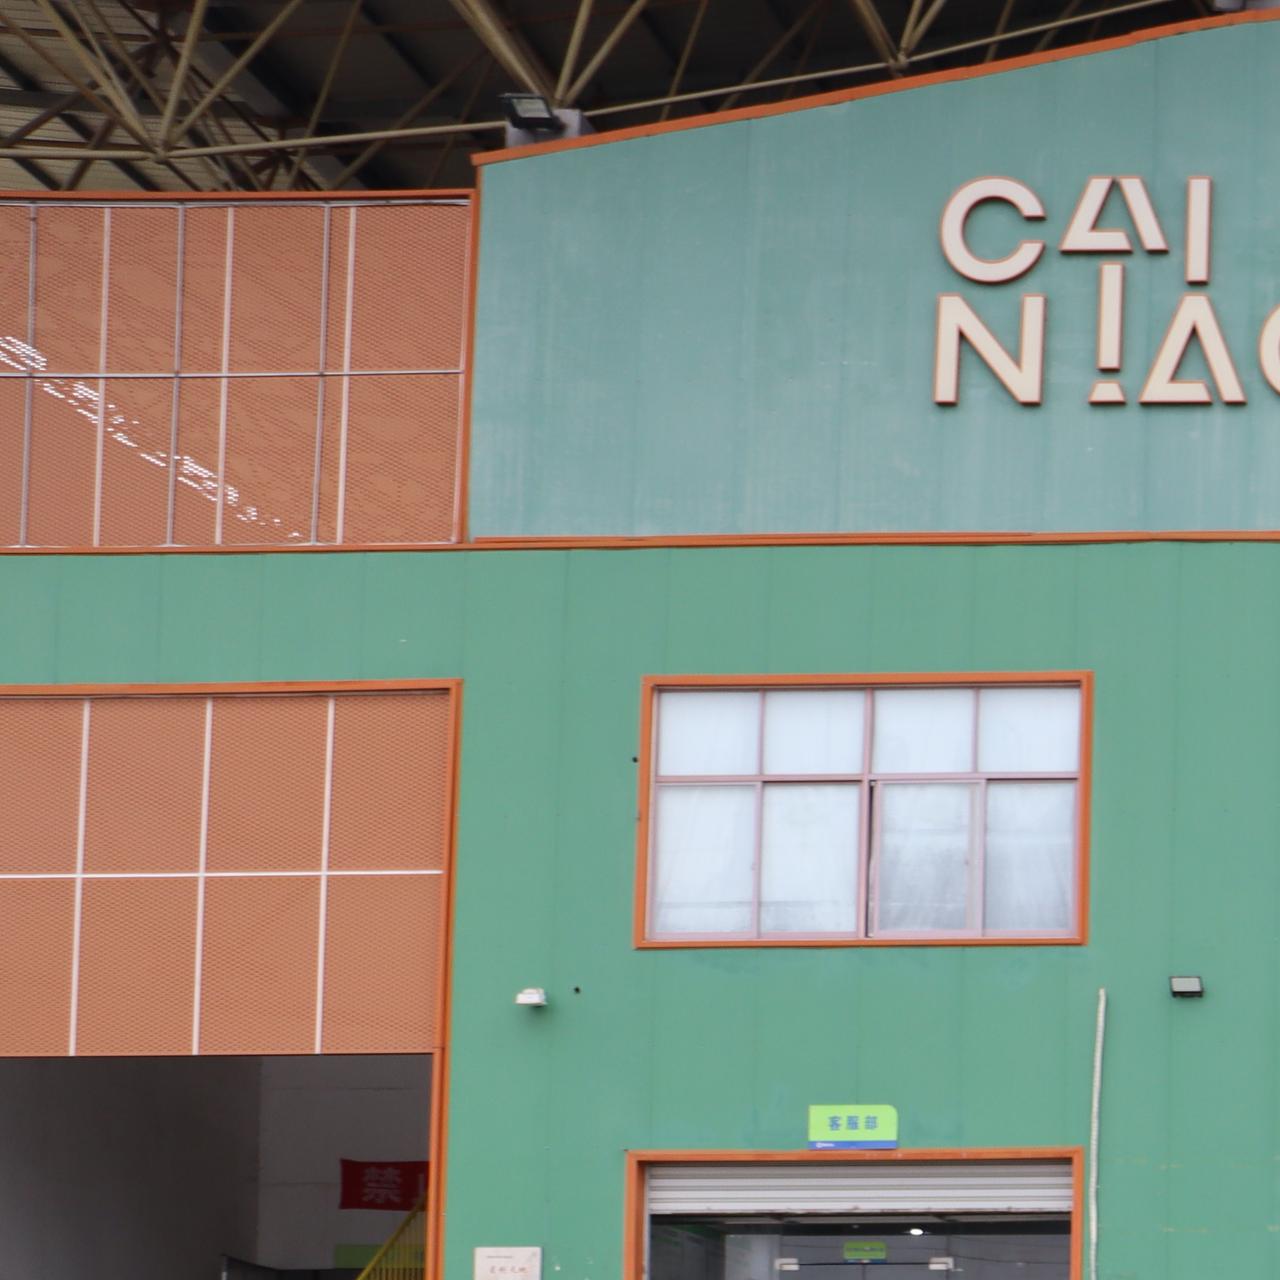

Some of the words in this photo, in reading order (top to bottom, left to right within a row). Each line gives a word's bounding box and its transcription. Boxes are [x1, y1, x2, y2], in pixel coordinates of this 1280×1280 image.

[940, 175, 1212, 284] CAI
[827, 1114, 879, 1132] 客服部
